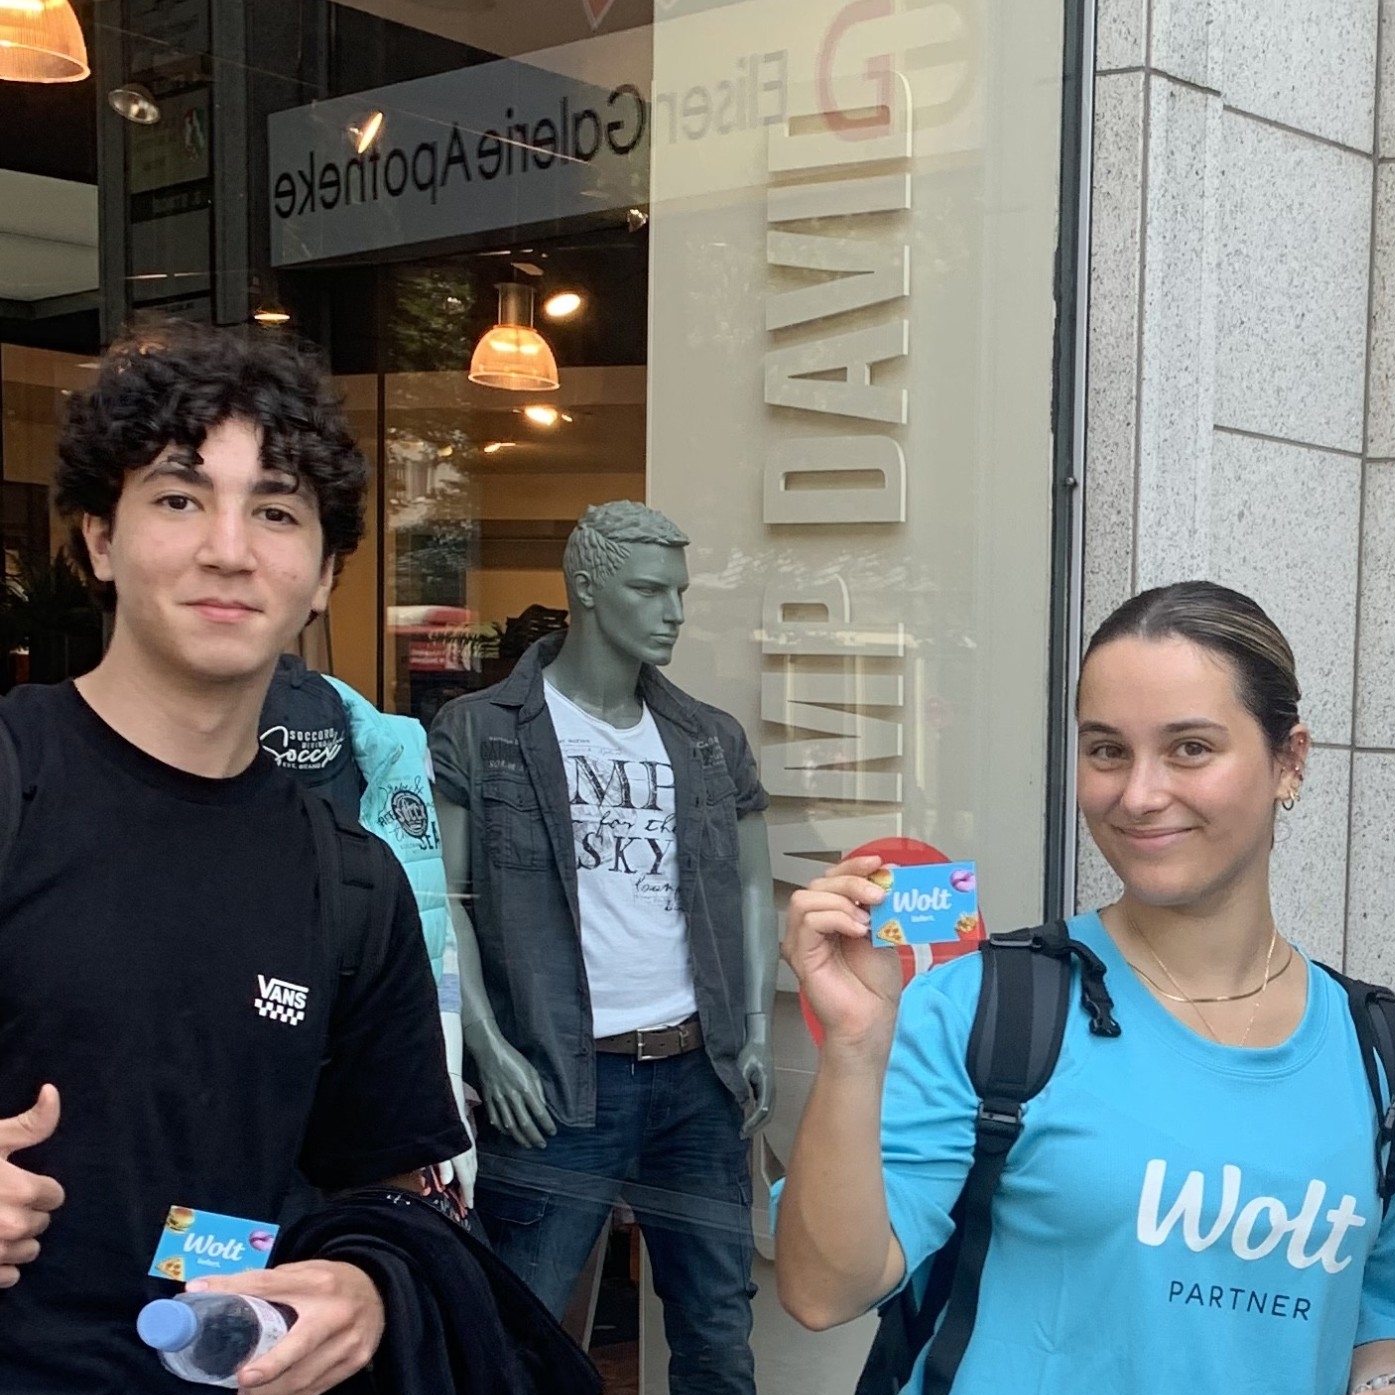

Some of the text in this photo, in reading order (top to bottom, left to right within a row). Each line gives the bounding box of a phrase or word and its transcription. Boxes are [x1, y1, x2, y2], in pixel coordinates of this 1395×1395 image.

[762, 70, 912, 524] DAVID
[576, 831, 675, 876] SKY
[892, 886, 953, 914] Wolt
[257, 974, 310, 1010] VANS
[1136, 1158, 1366, 1274] Wolt
[183, 1232, 246, 1262] Wolt
[1168, 1280, 1312, 1321] PARTNER
